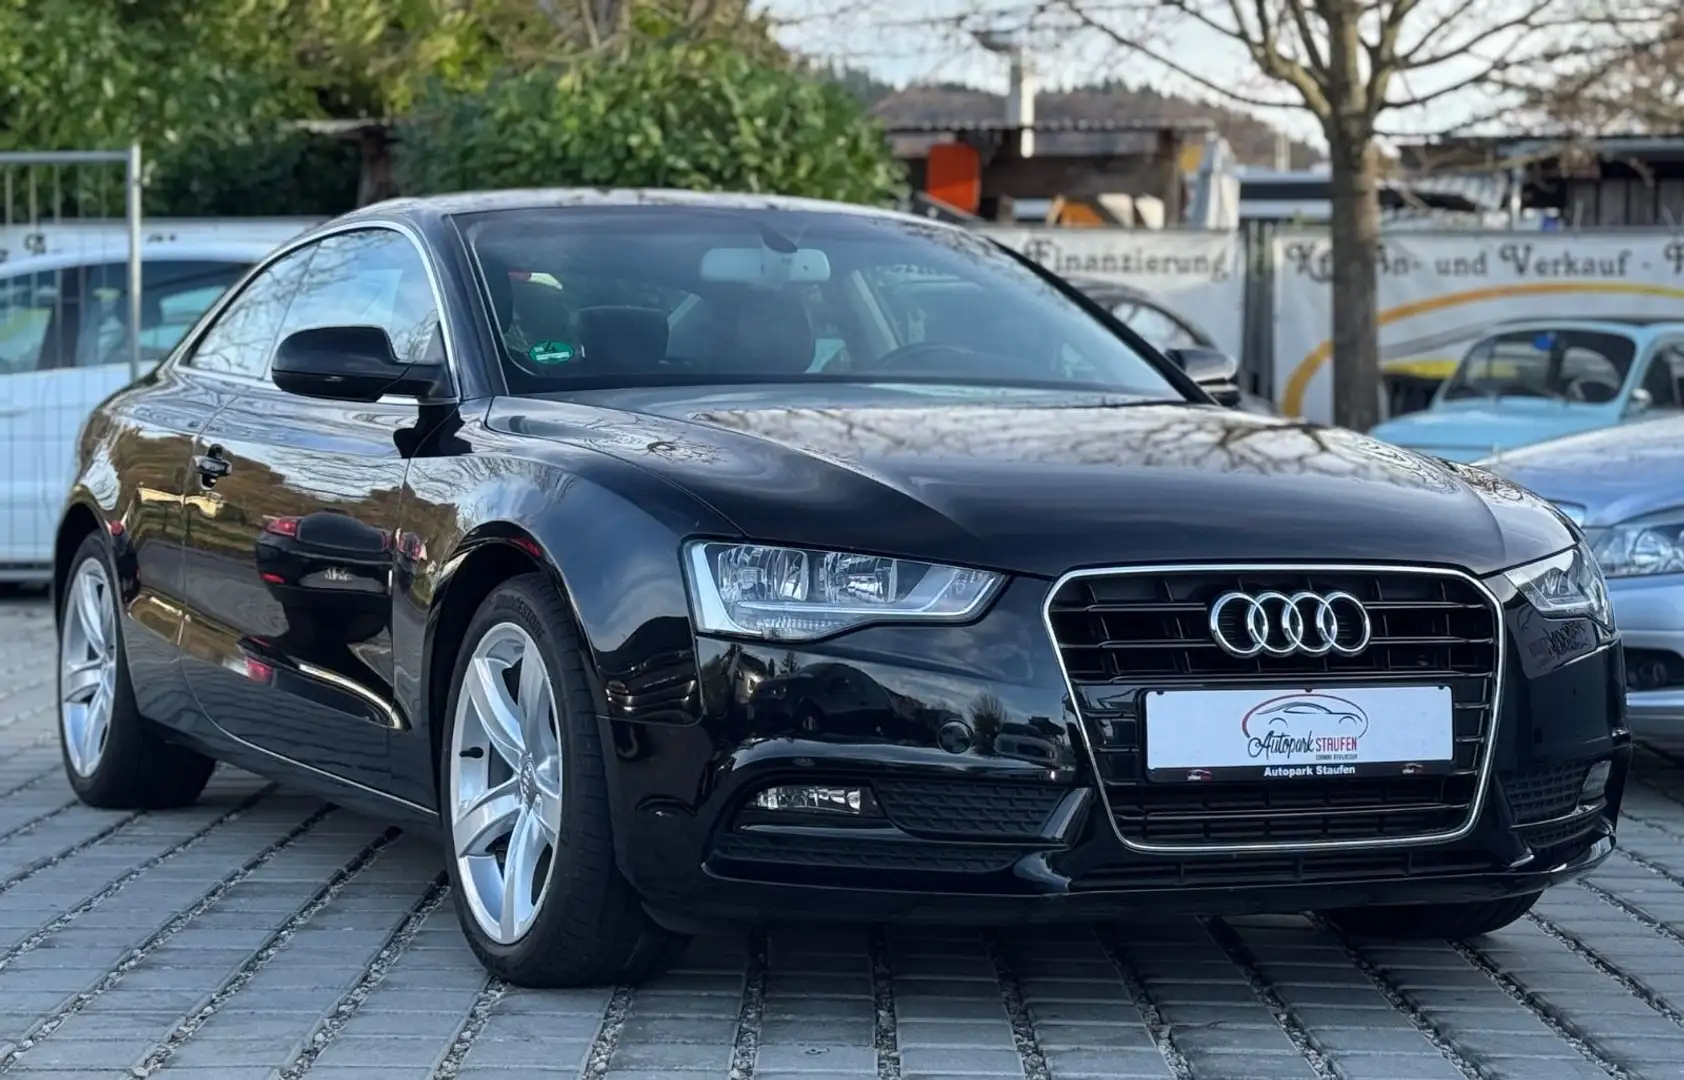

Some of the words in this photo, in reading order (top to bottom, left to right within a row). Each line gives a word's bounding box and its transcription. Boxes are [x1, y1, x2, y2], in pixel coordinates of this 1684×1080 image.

[1022, 238, 1228, 282] Finanzierung
[1435, 251, 1488, 277] und
[1498, 242, 1633, 277] Verkauf
[494, 593, 547, 638] DGESTONE
[1247, 729, 1315, 761] Autopark
[1315, 736, 1358, 753] STAUFEN
[1263, 766, 1314, 779] Autopark
[1315, 764, 1356, 776] Staufen
